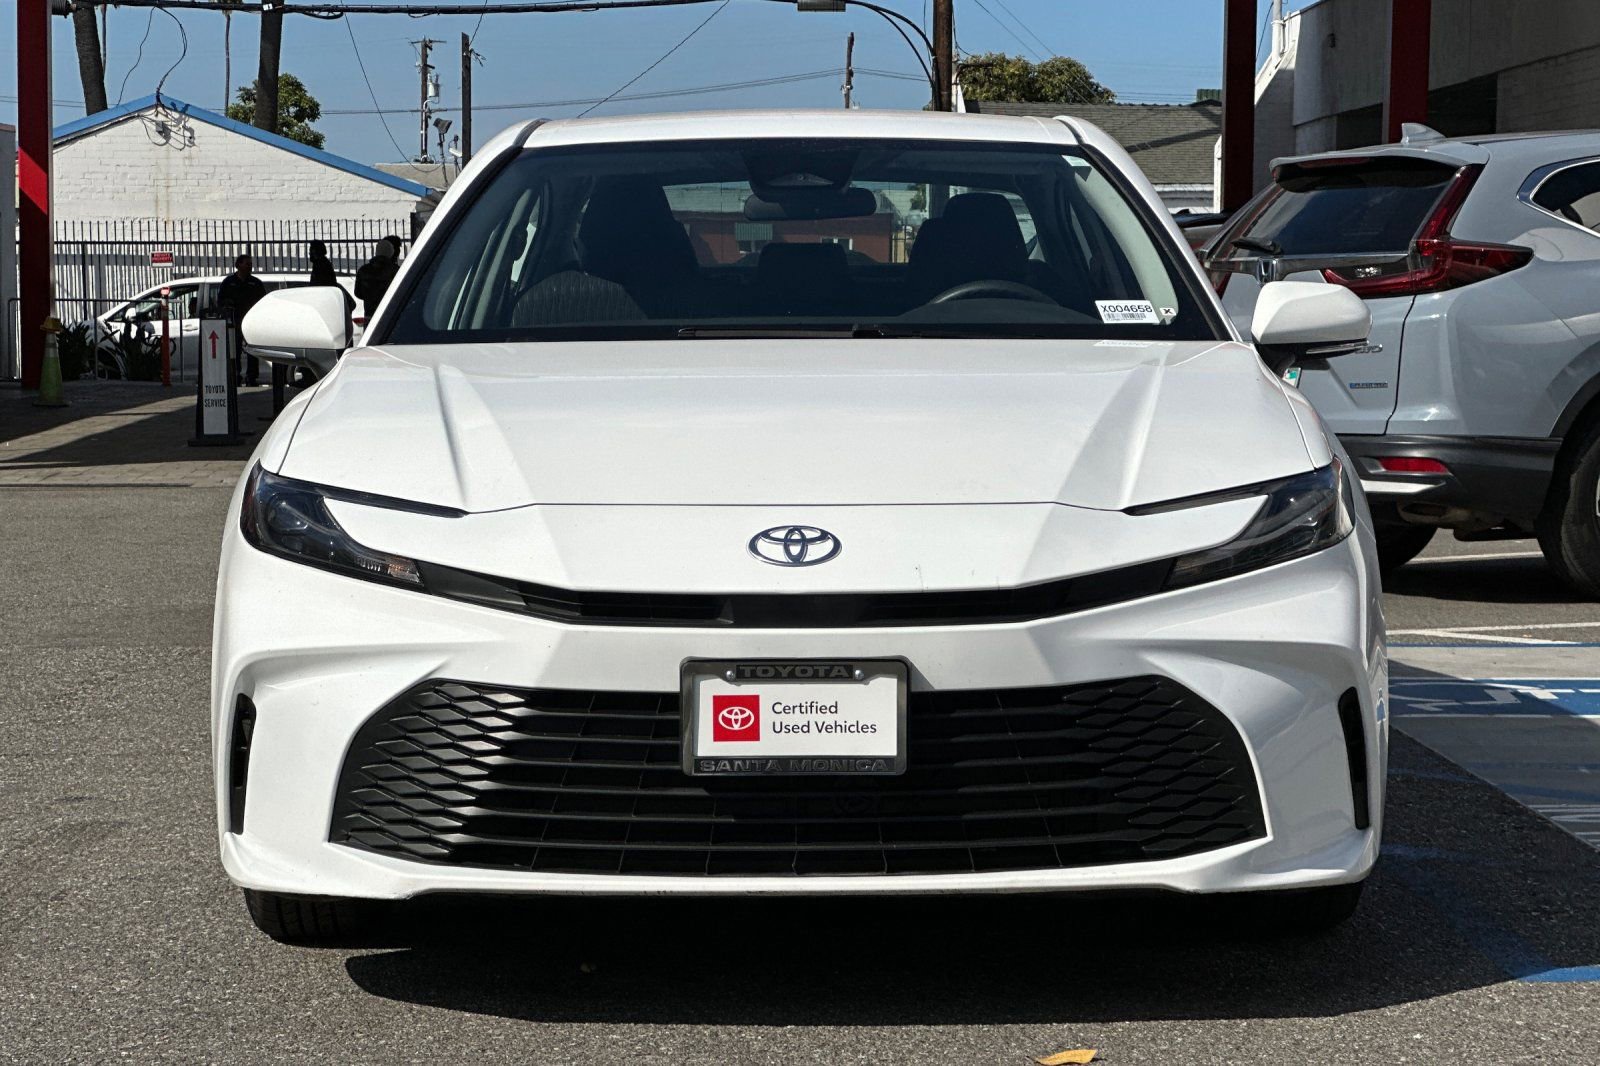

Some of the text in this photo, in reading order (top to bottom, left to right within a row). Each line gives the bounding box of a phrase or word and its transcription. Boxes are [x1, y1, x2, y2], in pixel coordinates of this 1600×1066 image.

[1100, 304, 1153, 313] X004658
[205, 385, 226, 394] TOYOTA
[204, 398, 227, 408] SERVICE
[739, 665, 850, 678] TOYOTA
[771, 701, 839, 715] Certified
[772, 720, 877, 734] Used Vehicles
[700, 759, 889, 772] SANTA MONICA
